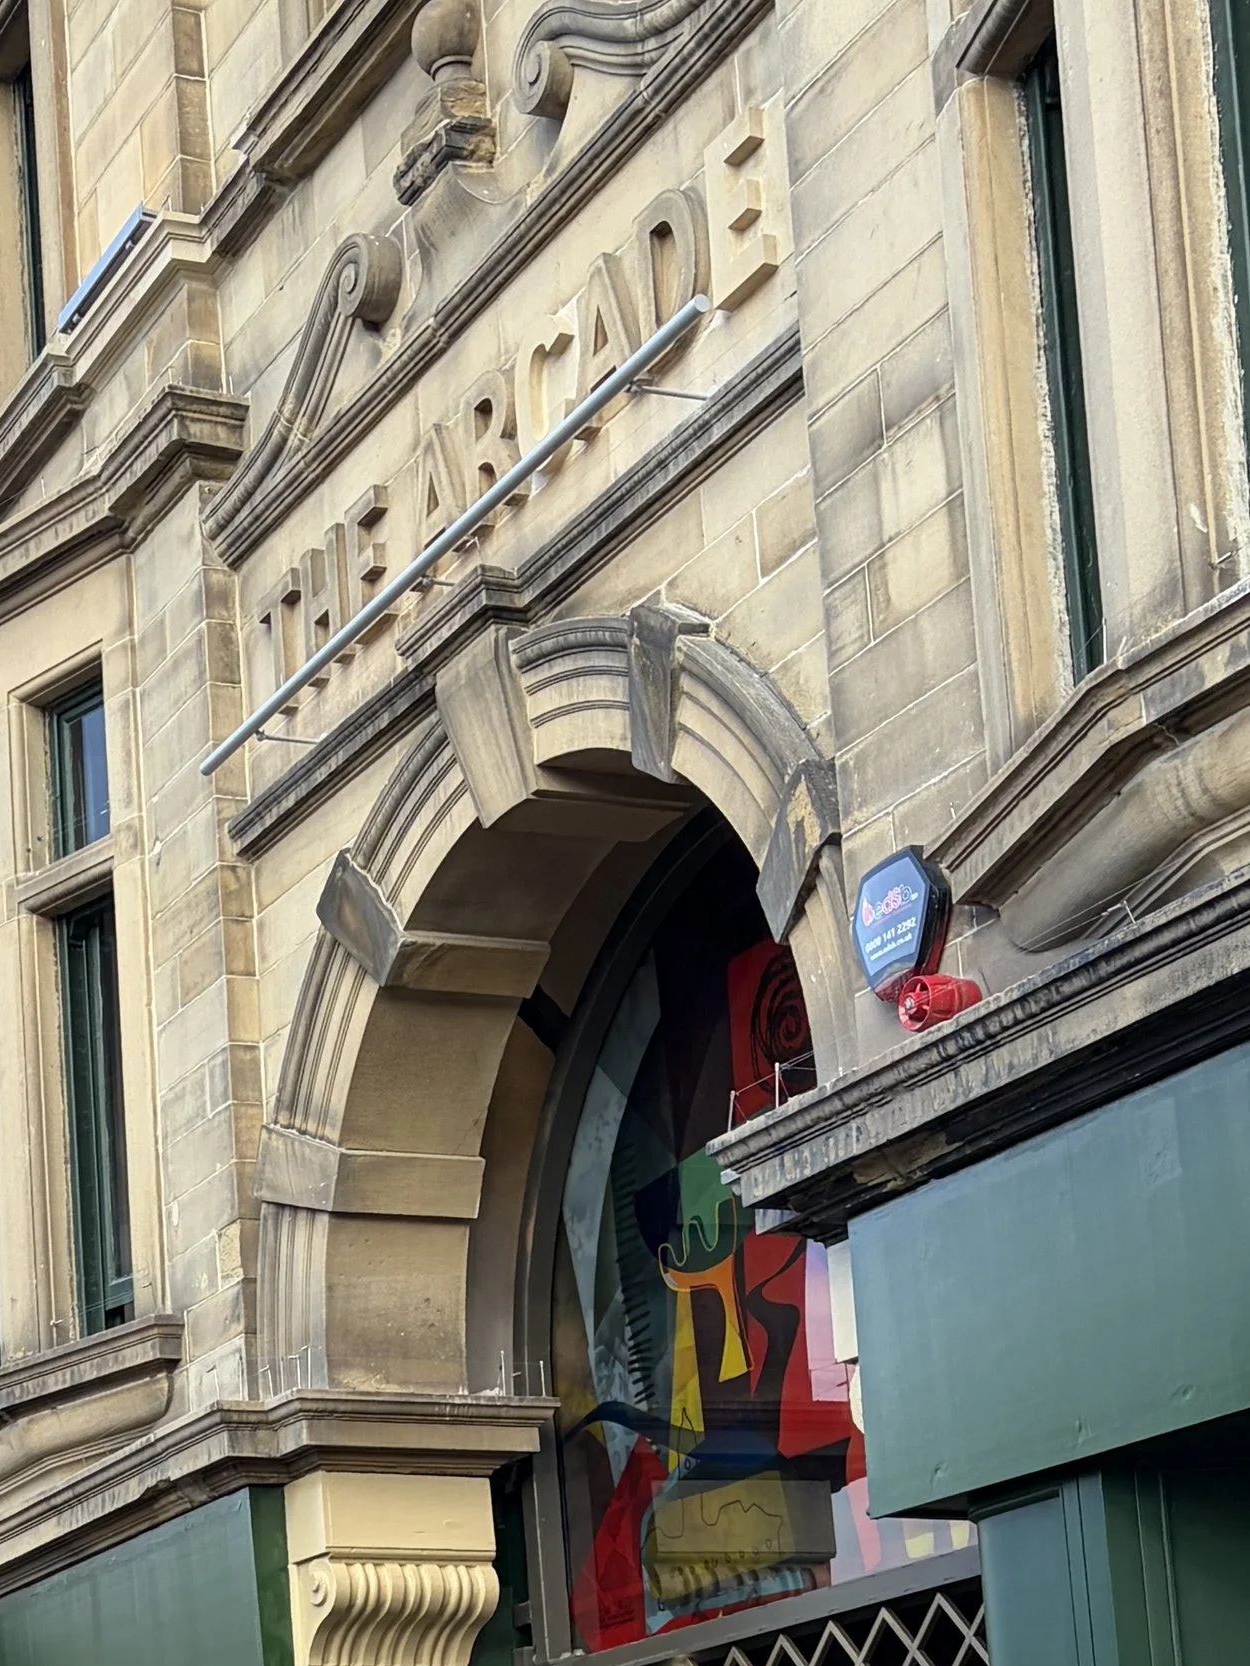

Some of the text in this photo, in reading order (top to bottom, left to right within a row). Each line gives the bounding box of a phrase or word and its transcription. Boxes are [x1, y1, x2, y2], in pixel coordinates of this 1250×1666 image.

[258, 105, 779, 715] THE ARCADE
[883, 927, 895, 942] 141
